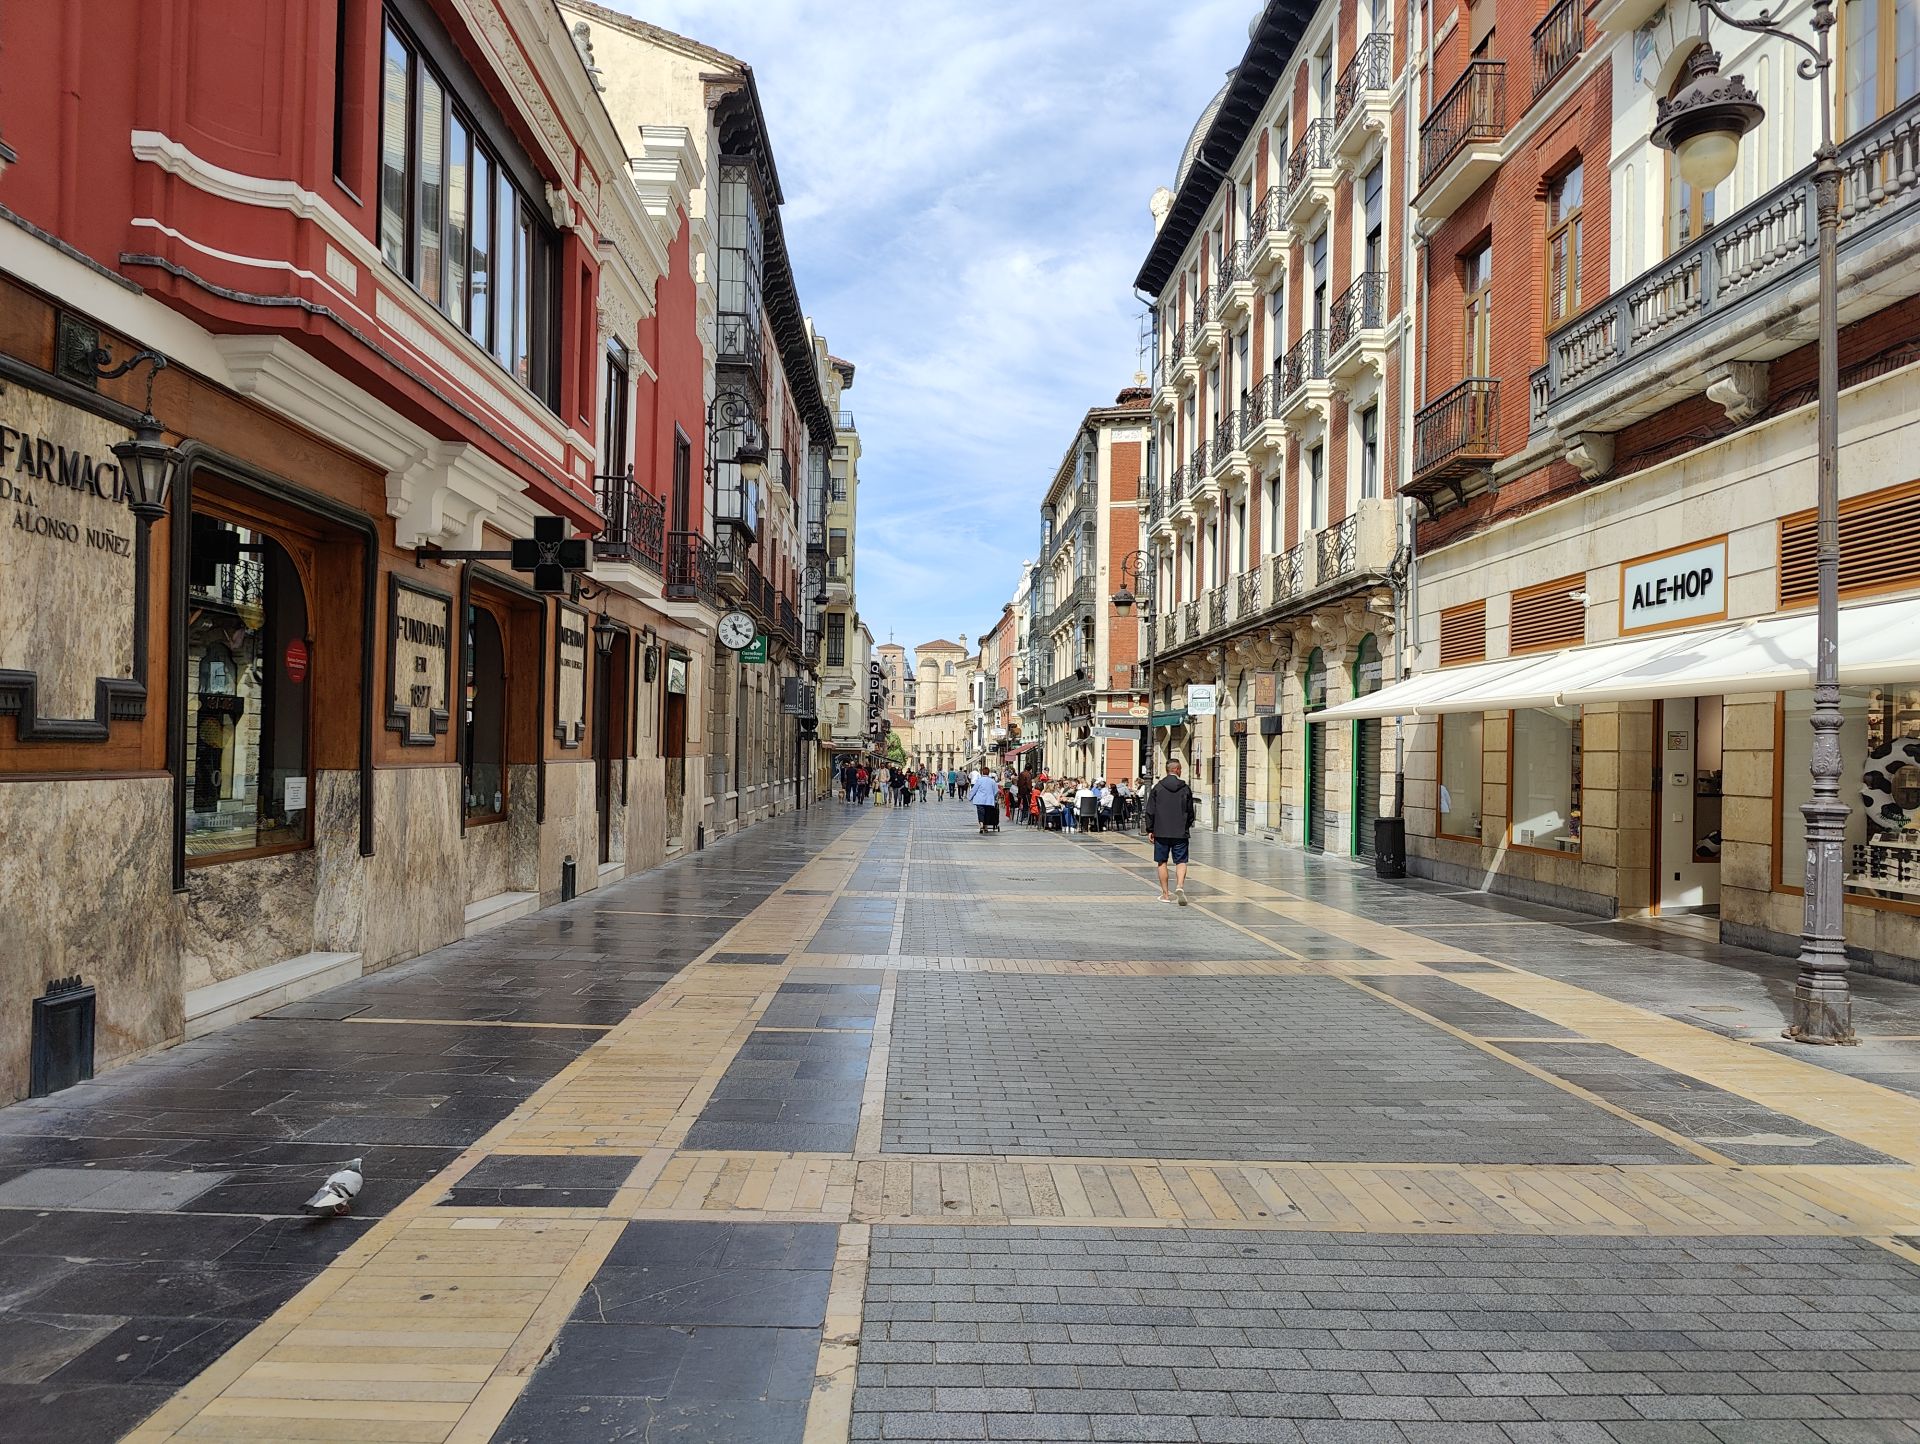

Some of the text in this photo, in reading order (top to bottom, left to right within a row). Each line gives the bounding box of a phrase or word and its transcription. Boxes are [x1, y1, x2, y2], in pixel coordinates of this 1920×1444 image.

[12, 509, 131, 558] ALONSO NUÑEZ
[1632, 567, 1714, 610] ALE-HOP
[396, 616, 445, 649] FUNDADA
[415, 656, 427, 673] EN
